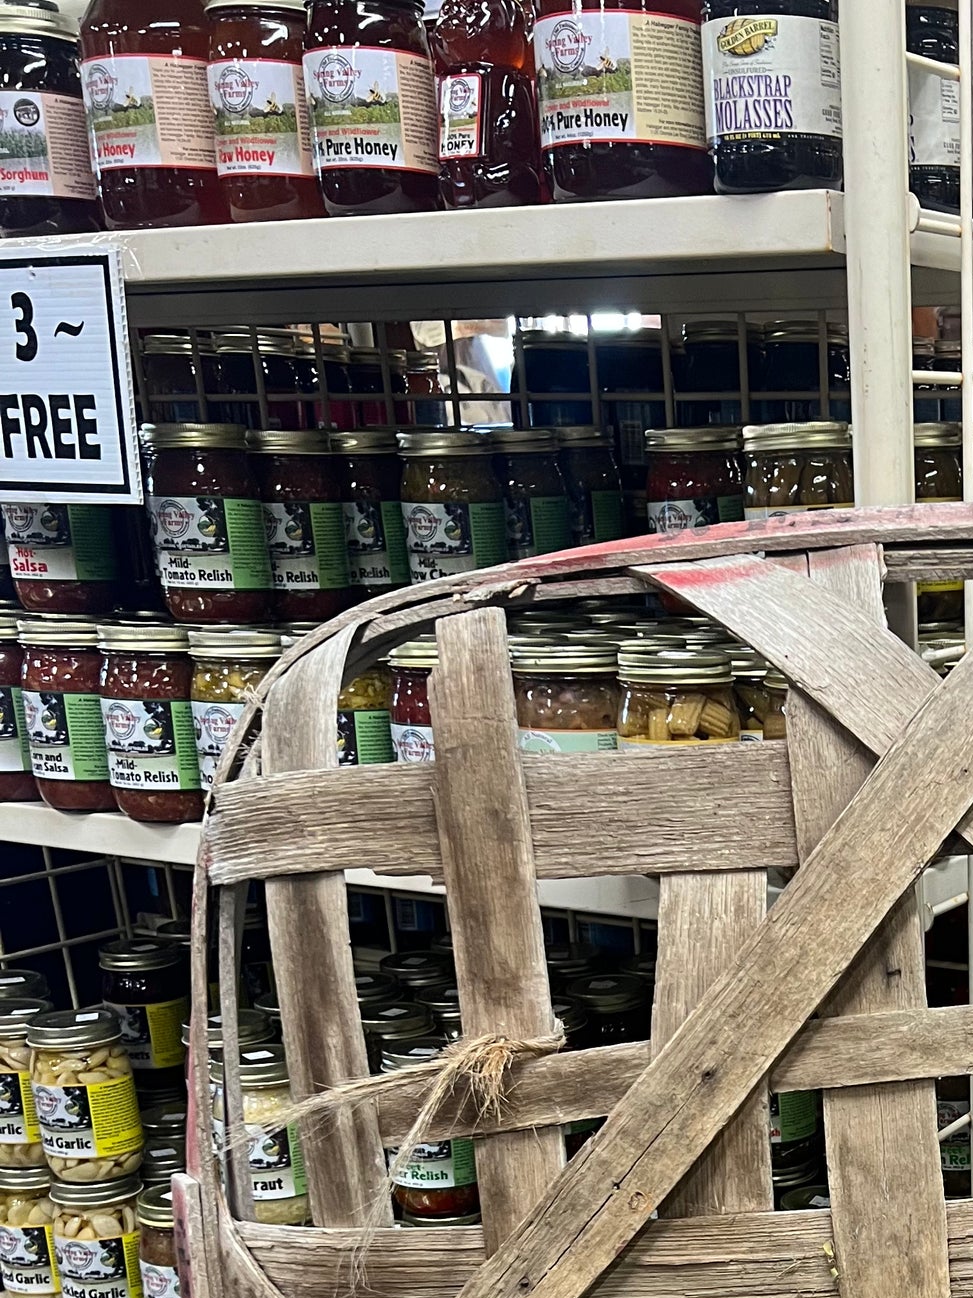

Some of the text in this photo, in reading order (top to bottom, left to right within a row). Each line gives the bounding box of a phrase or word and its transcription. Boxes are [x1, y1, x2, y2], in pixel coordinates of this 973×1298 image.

[720, 20, 773, 51] GOLDEN BARREL
[713, 75, 792, 100] BLACKSTRAP
[557, 111, 581, 130] Pure
[584, 108, 628, 132] Honey
[715, 99, 793, 132] MOLASSES
[103, 142, 135, 158] Honey
[326, 137, 398, 161] Pure Honey
[235, 147, 275, 166] Honey
[0, 167, 49, 183] Sorghum
[11, 291, 38, 362] 3
[0, 394, 101, 460] FREE
[13, 558, 48, 572] Salsa
[162, 568, 233, 582] Tomato Relish
[272, 571, 319, 583] to Relish
[360, 567, 390, 579] Relish
[45, 753, 62, 762] and
[44, 762, 69, 773] Salsa
[111, 768, 179, 783] Tomato Relish
[129, 1052, 150, 1060] eets
[56, 1137, 92, 1150] Garlic
[411, 1170, 449, 1181] Relish
[254, 1178, 284, 1192] raut
[15, 1274, 51, 1285] Garlic
